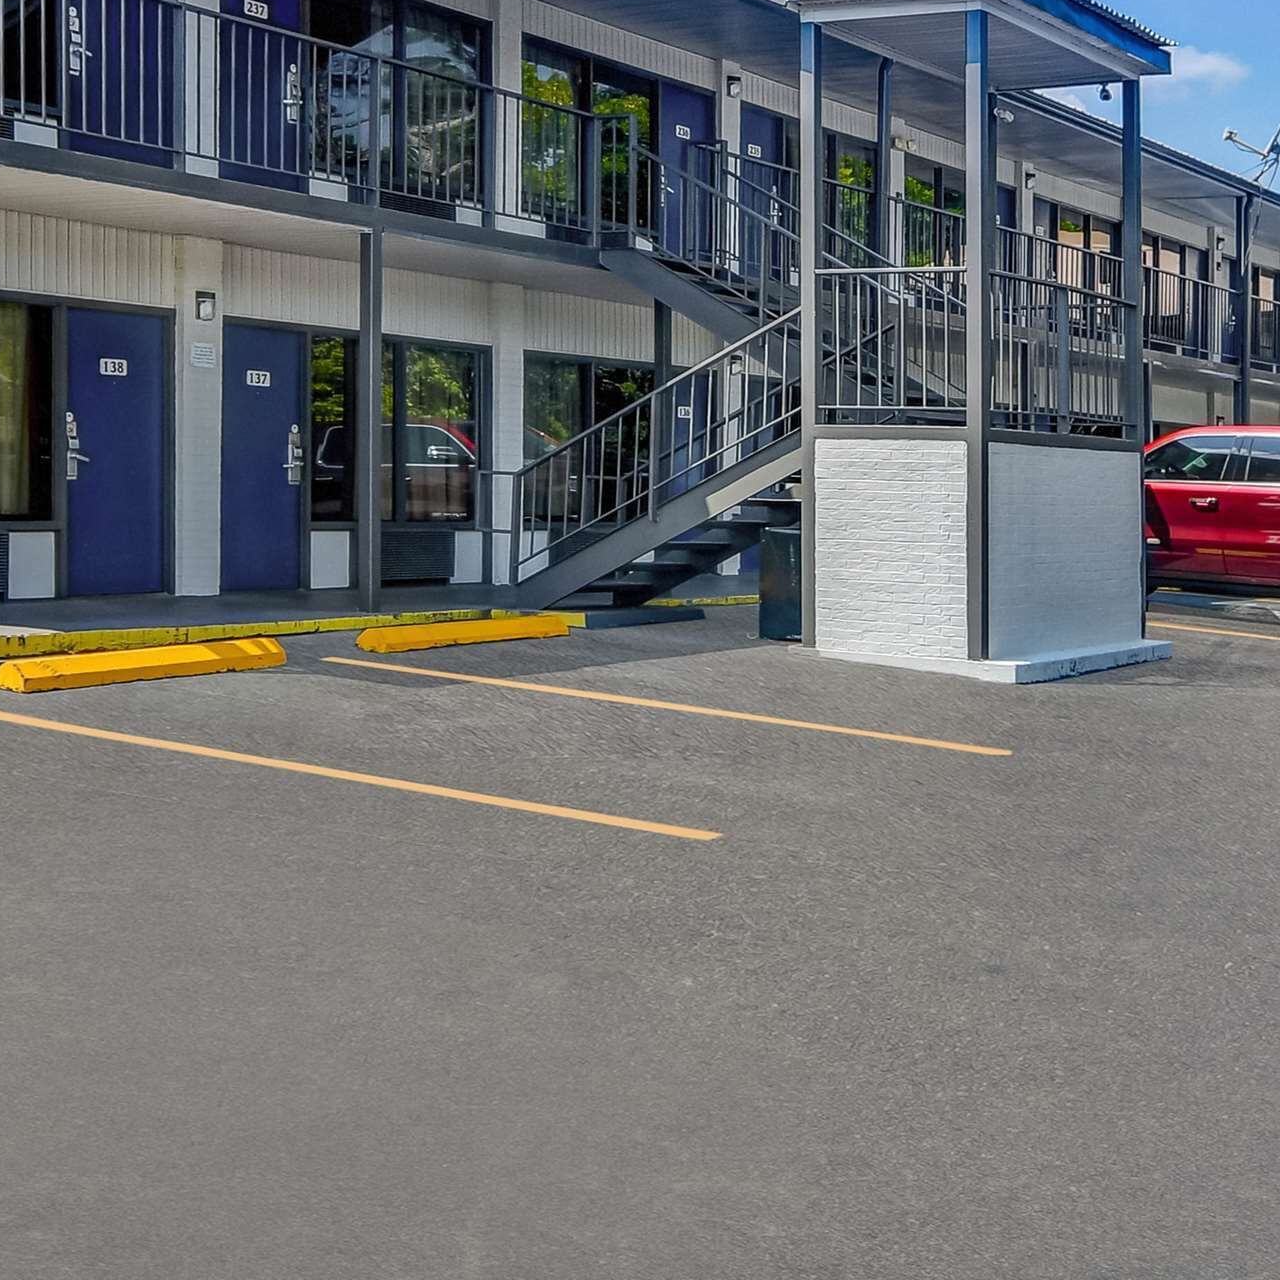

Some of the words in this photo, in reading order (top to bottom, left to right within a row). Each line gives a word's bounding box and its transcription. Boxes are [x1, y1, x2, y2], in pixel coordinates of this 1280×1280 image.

[246, 1, 266, 17] 237
[103, 361, 125, 374] 138
[249, 372, 268, 385] 137
